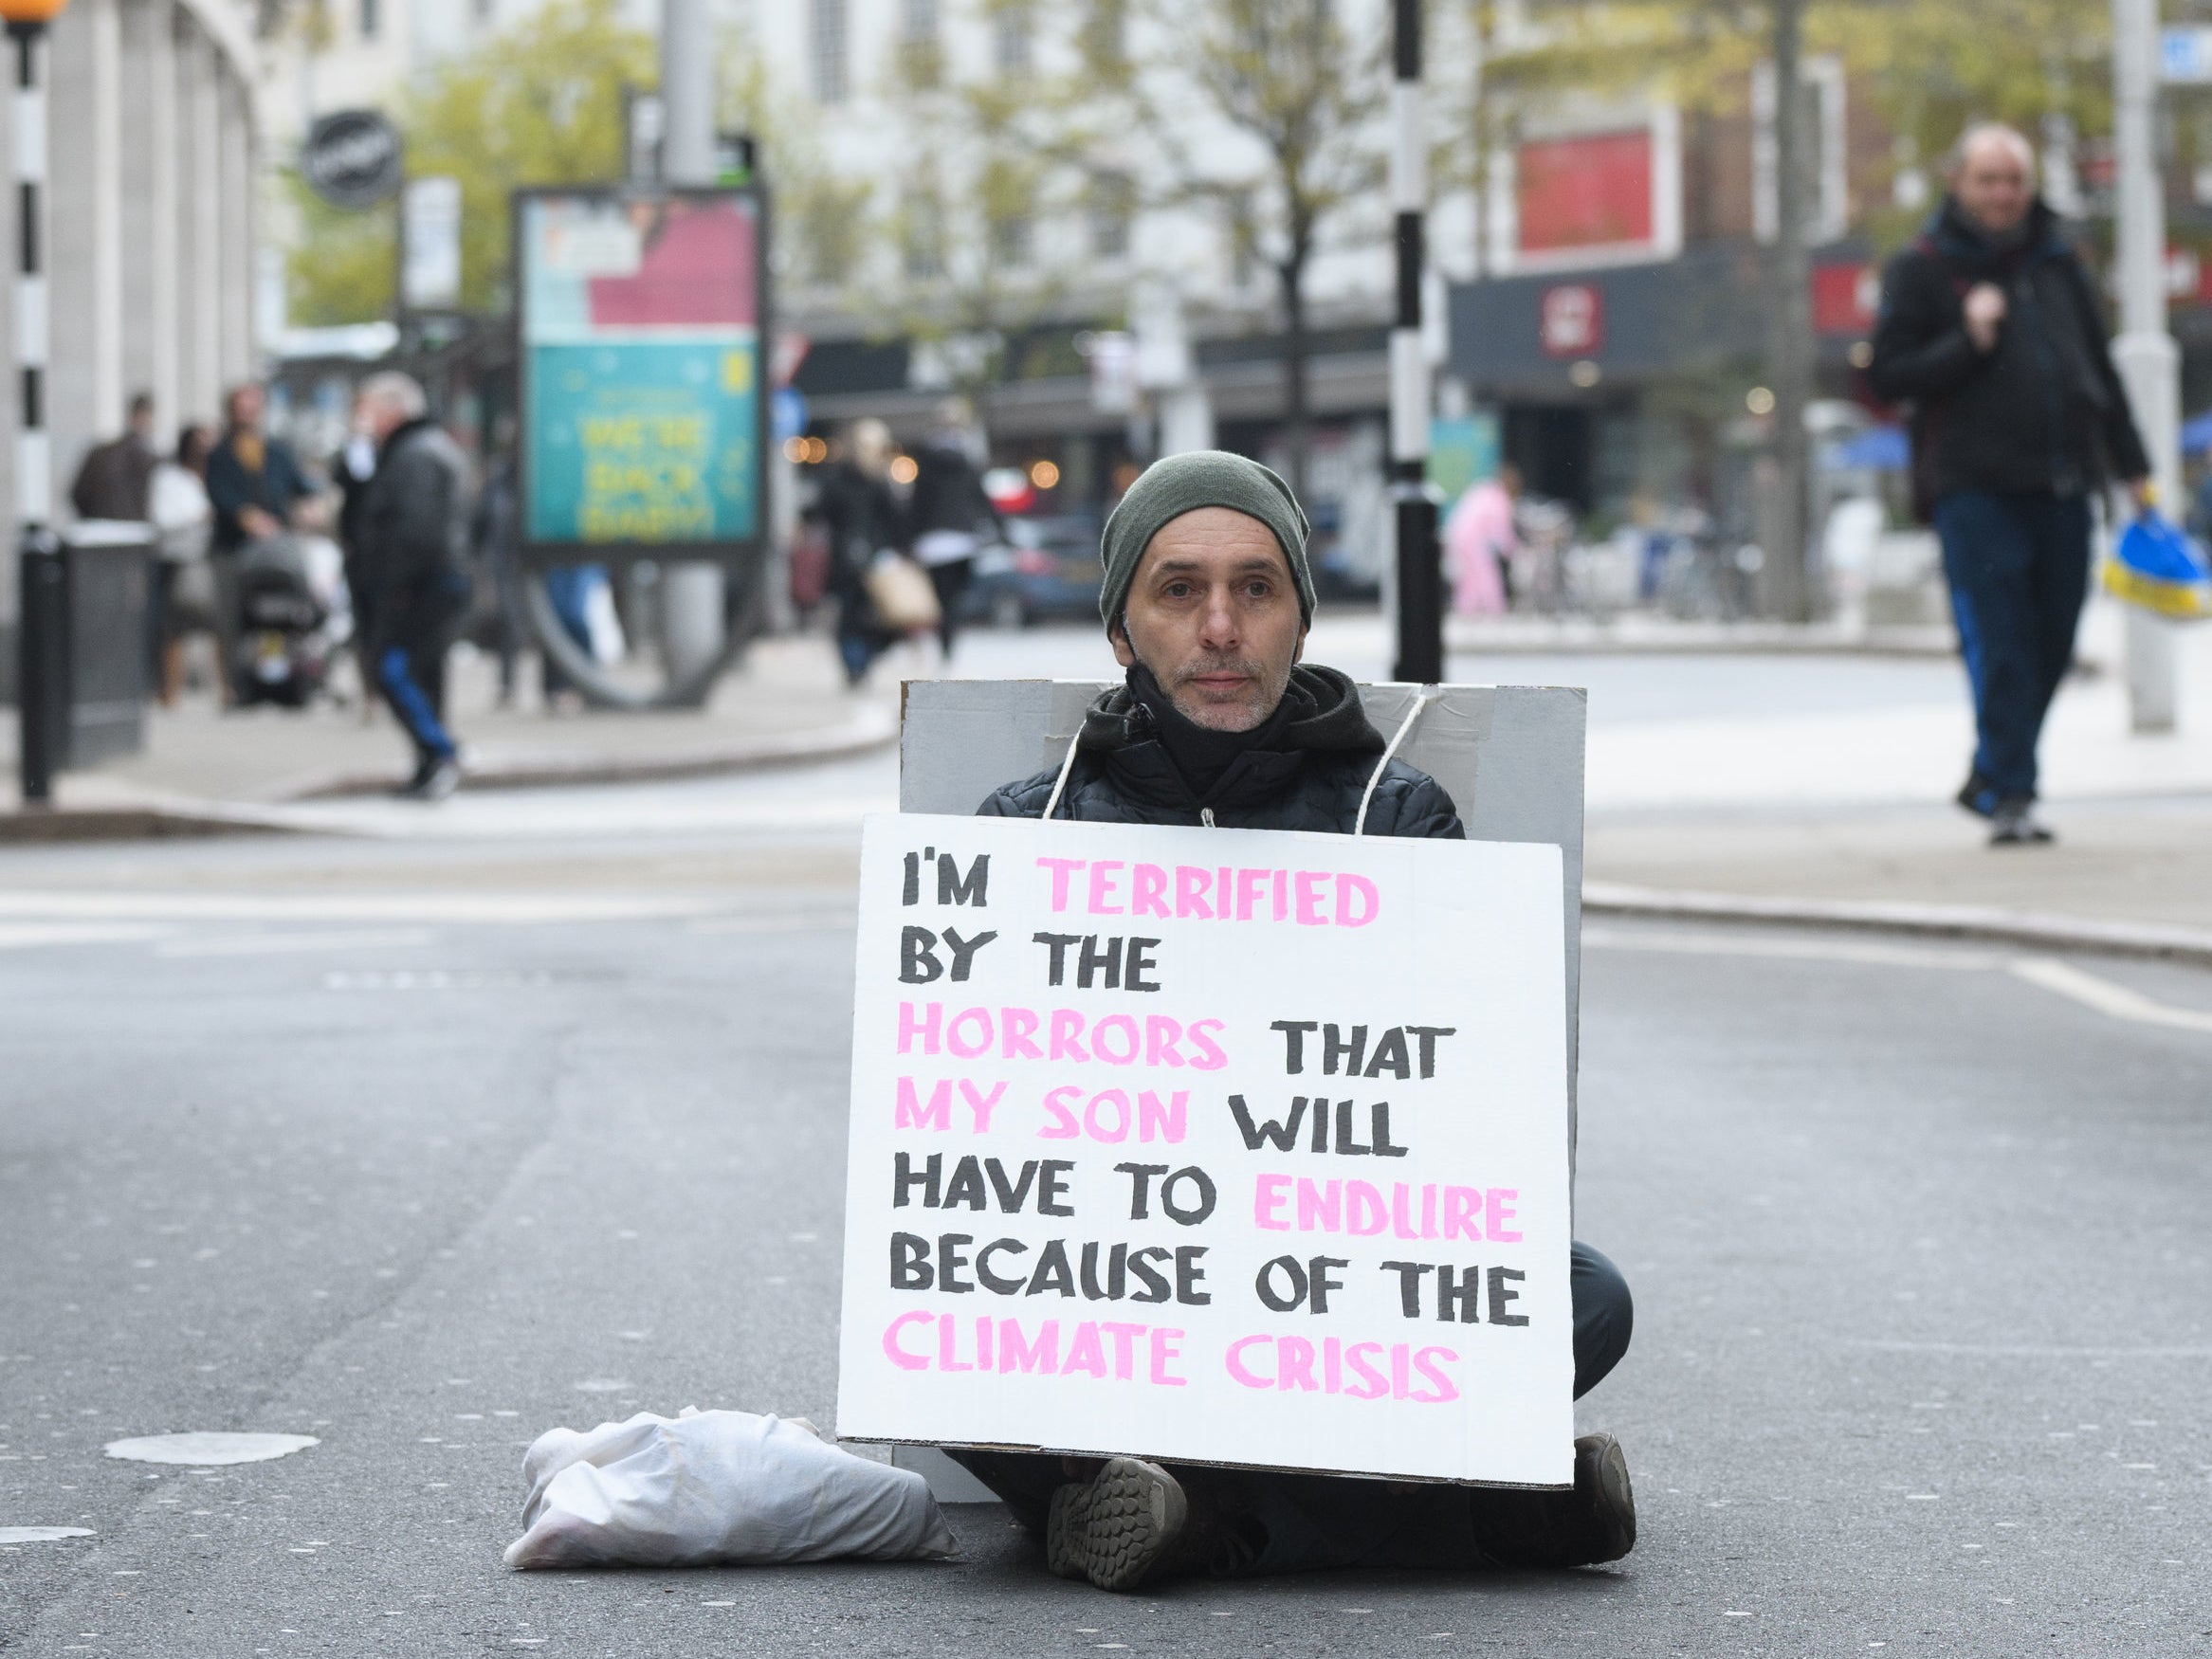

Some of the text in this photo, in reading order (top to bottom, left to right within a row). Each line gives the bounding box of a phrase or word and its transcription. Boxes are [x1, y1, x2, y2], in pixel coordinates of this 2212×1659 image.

[903, 847, 1380, 927] I'M TERRIFIED
[898, 925, 1161, 993] BY THE
[897, 1001, 1456, 1080] HORRORS THAT
[894, 1076, 1409, 1157] MY SON WILL
[893, 1151, 1524, 1243] HAVE TO ENDURE
[889, 1231, 1530, 1327] BECAUSE OF THE
[882, 1310, 1460, 1403] CLIMATE CRISIS
